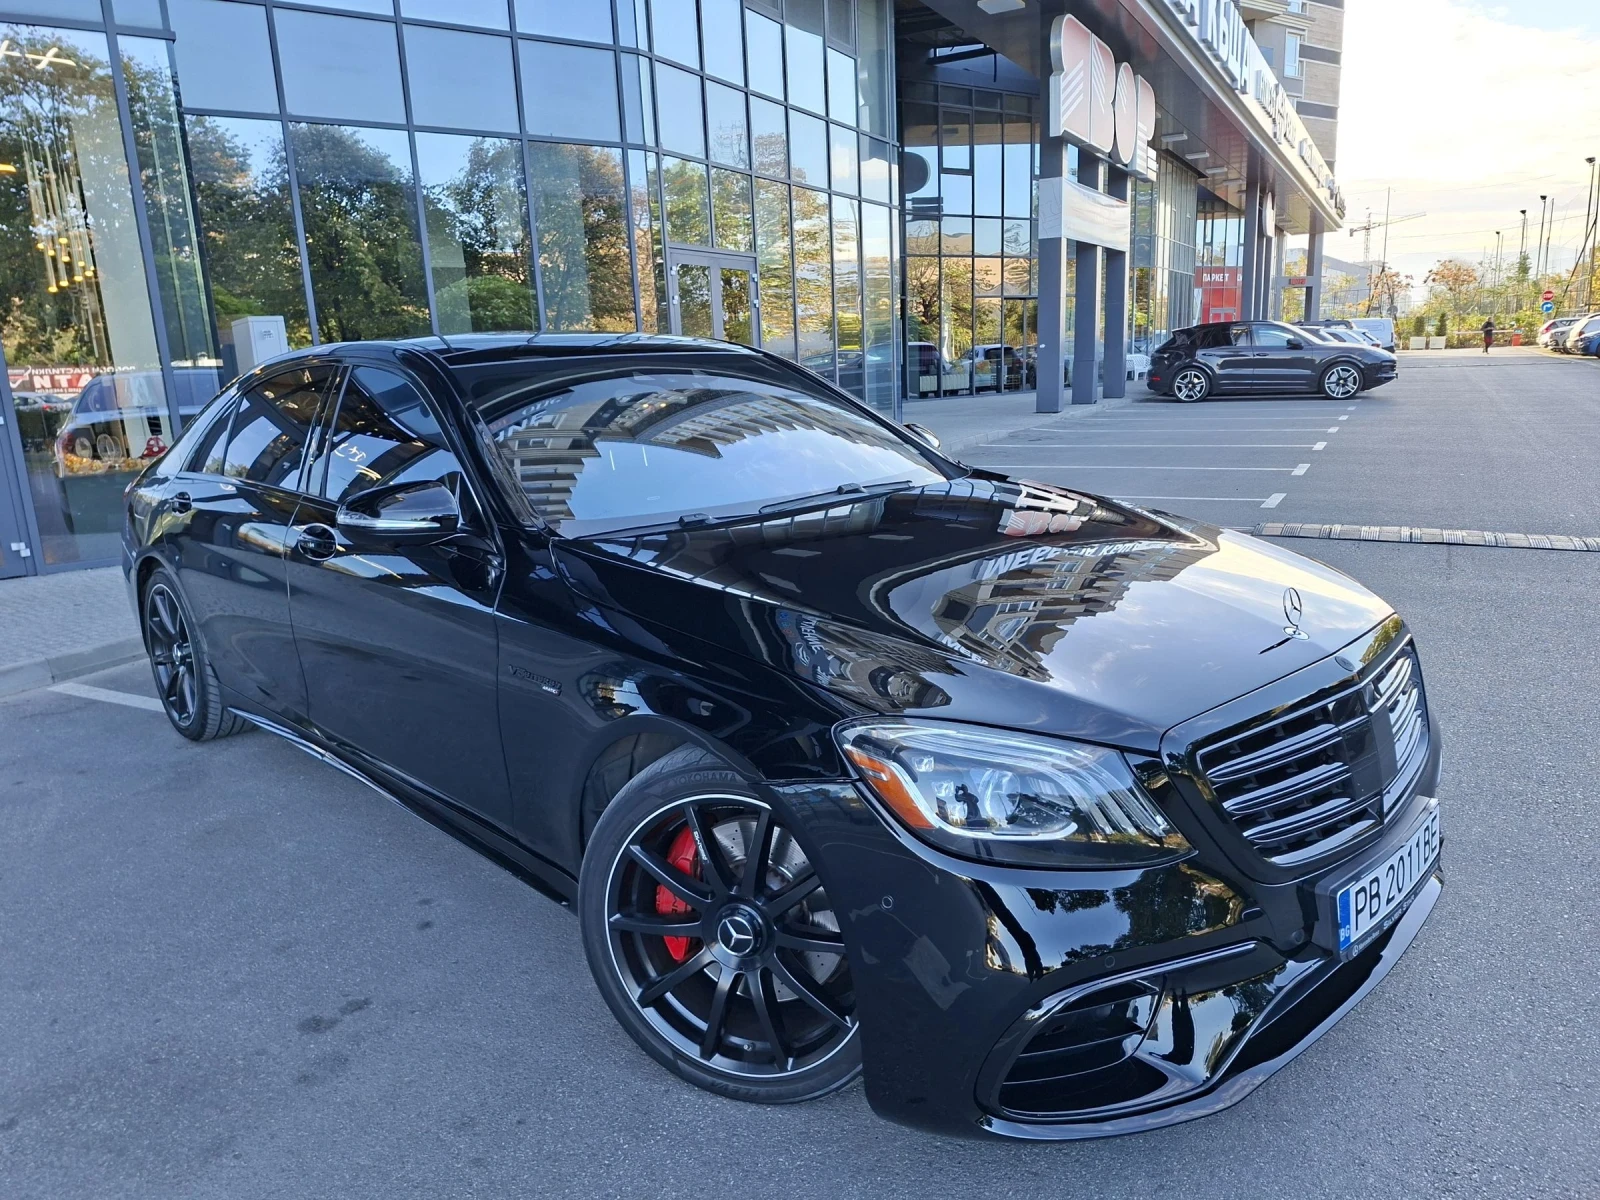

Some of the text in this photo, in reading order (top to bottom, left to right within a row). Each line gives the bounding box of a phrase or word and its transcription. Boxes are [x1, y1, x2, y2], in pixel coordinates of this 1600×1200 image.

[674, 772, 737, 785] YOKOHAMA
[1355, 813, 1438, 931] PB 2011 BE
[1339, 924, 1350, 942] BG
